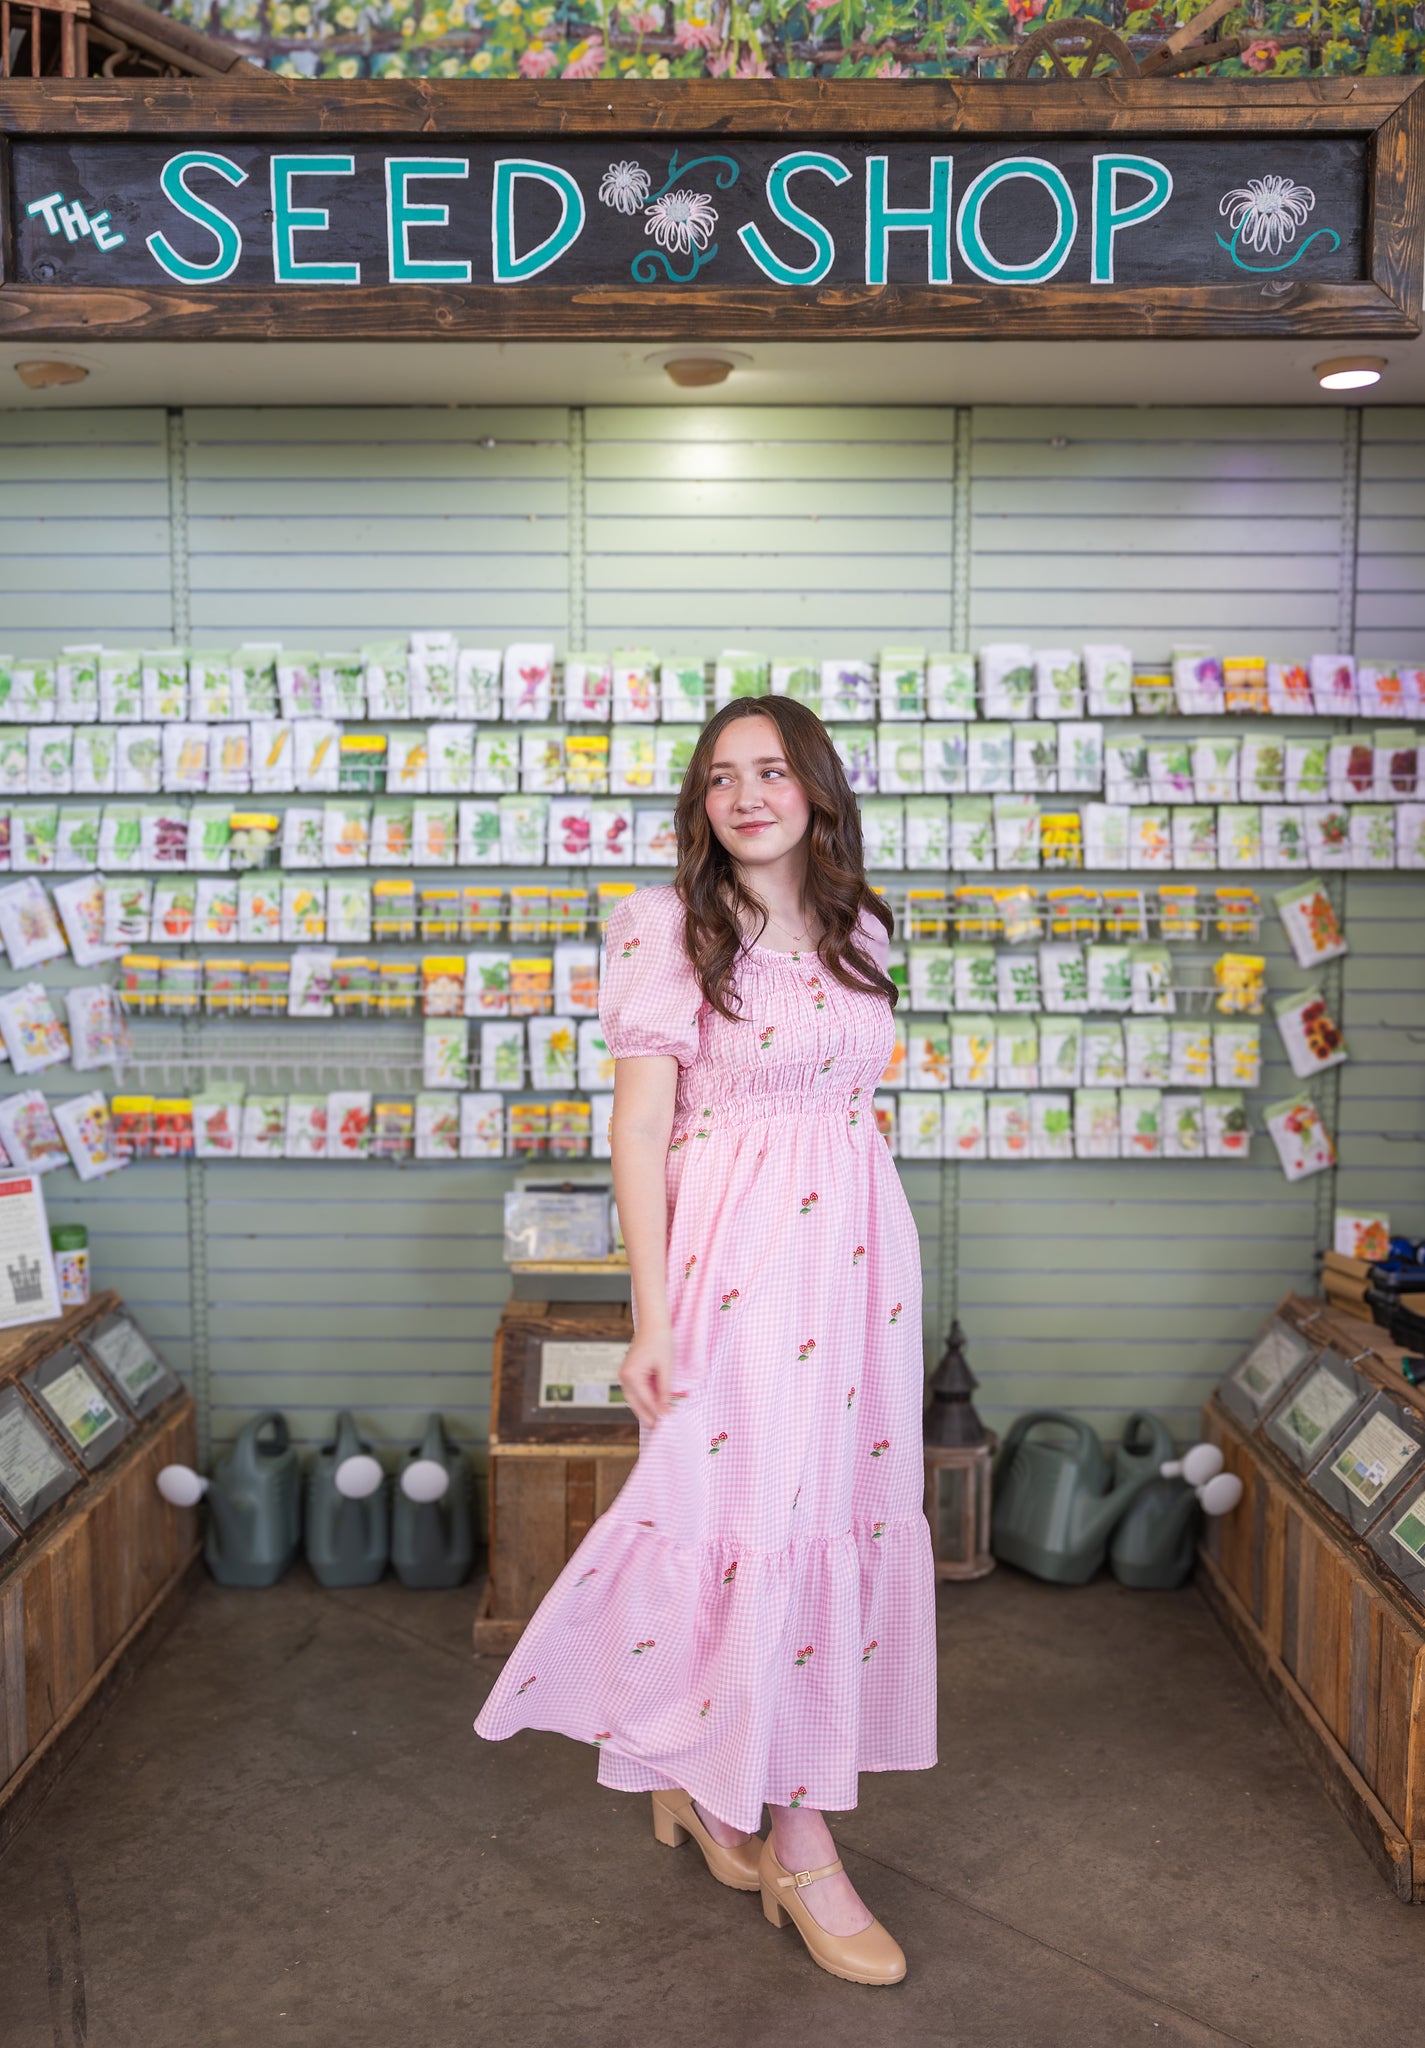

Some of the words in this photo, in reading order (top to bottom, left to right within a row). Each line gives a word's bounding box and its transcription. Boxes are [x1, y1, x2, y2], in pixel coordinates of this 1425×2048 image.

[26, 192, 126, 252] THE
[146, 151, 585, 285] SEED
[737, 151, 1173, 285] SHOP
